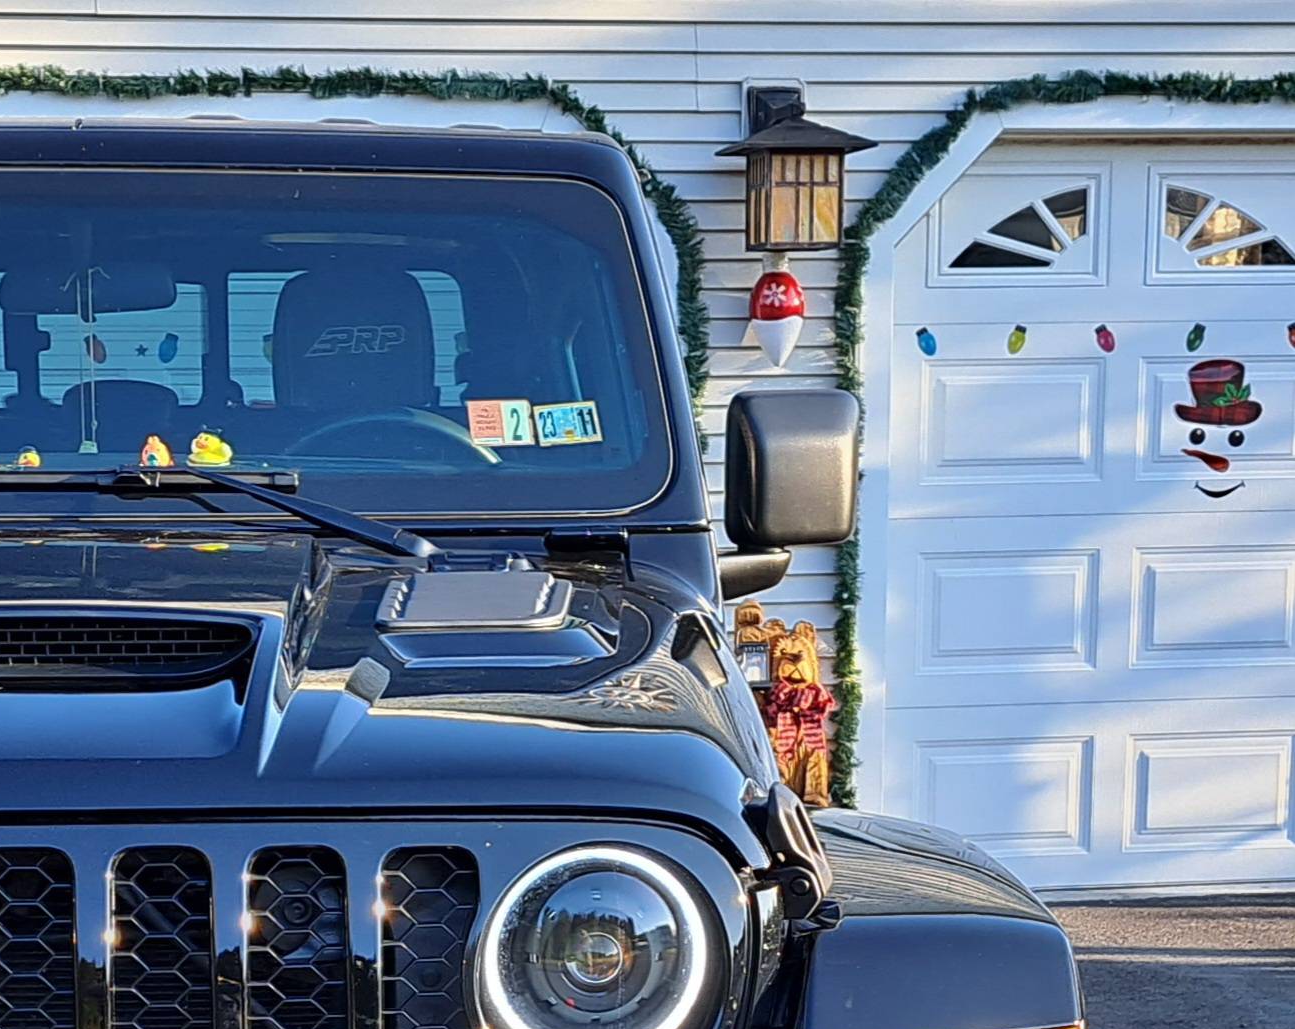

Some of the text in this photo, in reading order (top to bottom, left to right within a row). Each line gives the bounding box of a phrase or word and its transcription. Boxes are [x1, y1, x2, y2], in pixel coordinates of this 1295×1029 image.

[304, 325, 406, 357] PRP
[510, 408, 523, 441] 2
[539, 411, 557, 438] 23
[577, 408, 597, 436] 11
